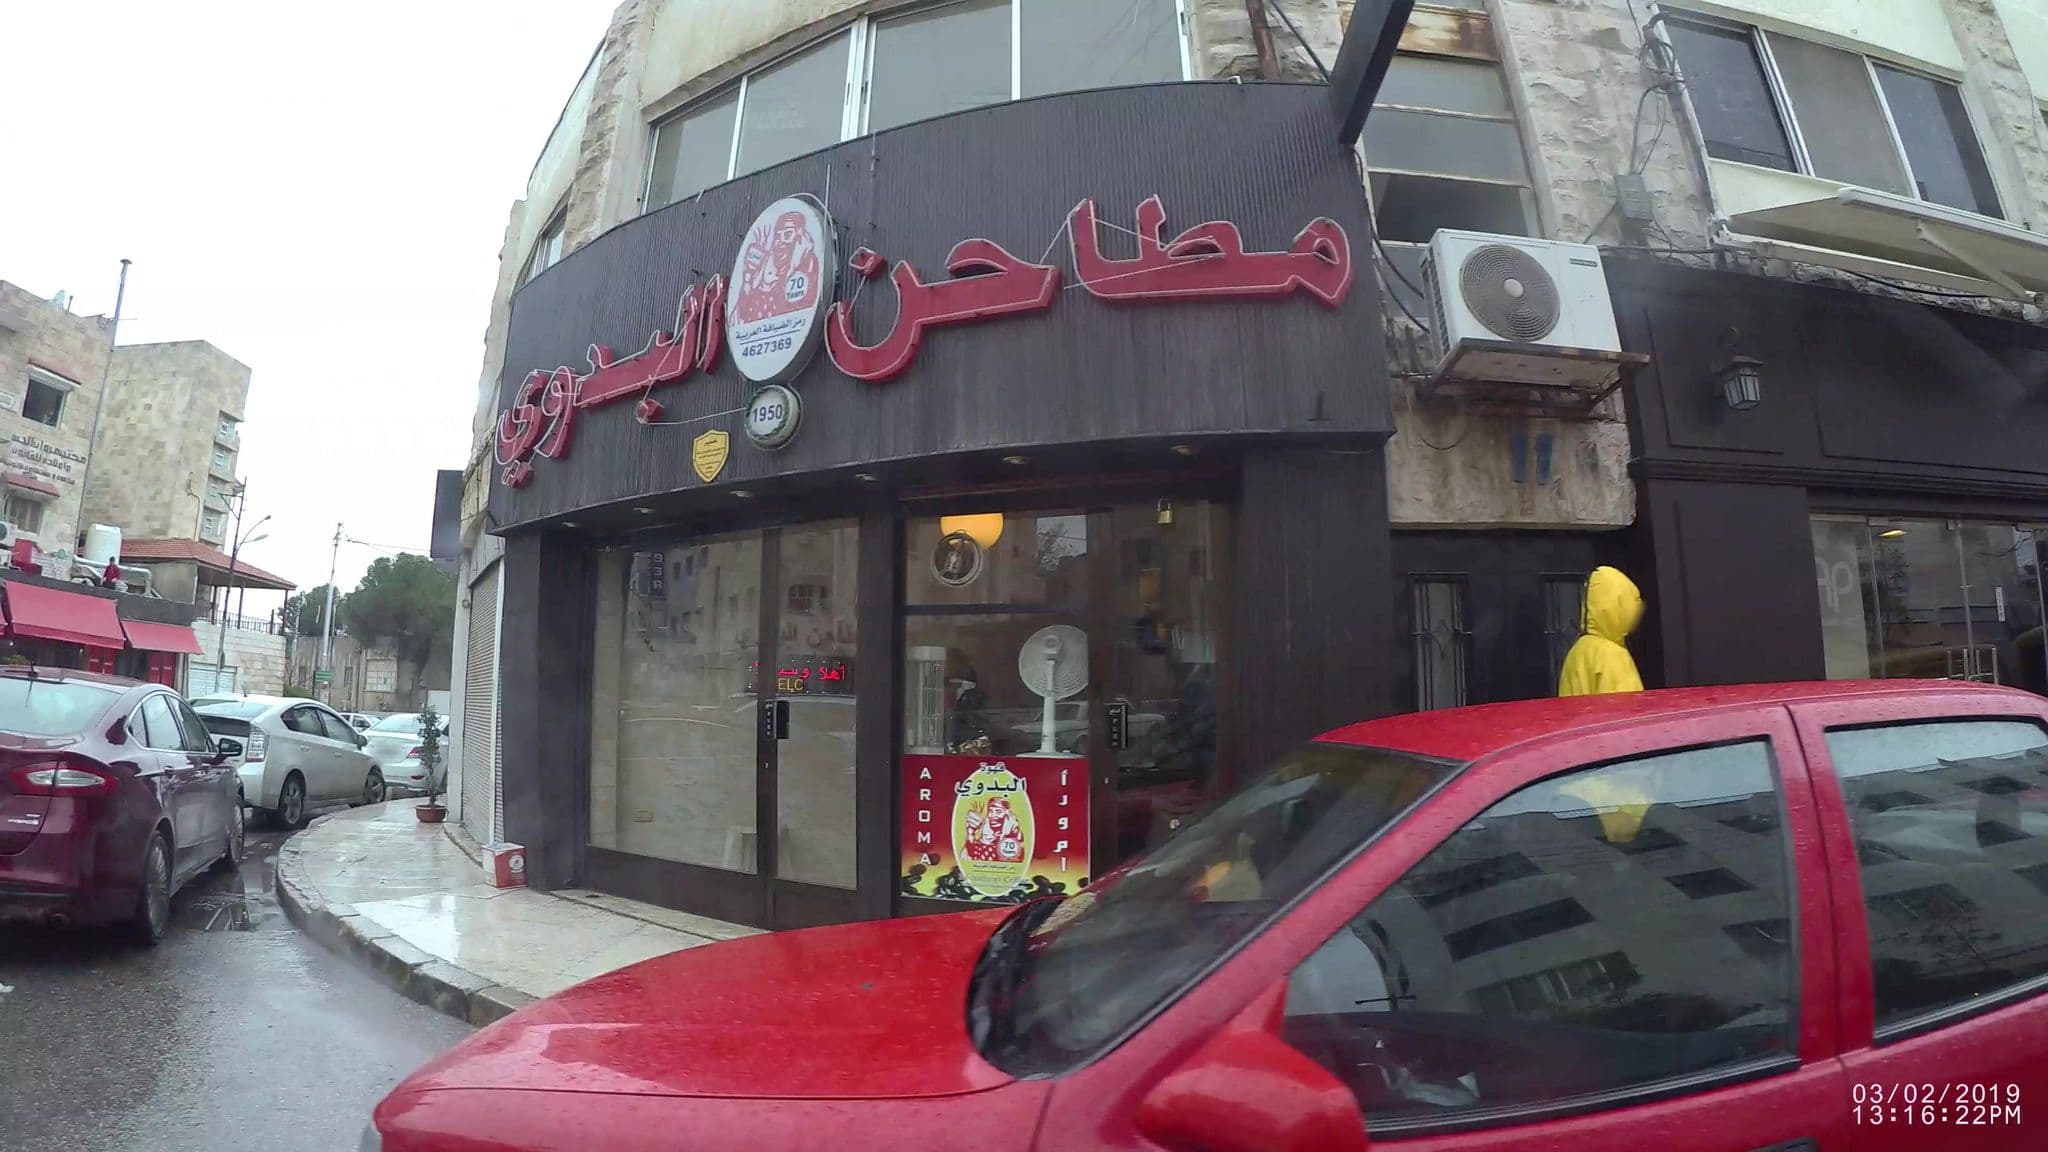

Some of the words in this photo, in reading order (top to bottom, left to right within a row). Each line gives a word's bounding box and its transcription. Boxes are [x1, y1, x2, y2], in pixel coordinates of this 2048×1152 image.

[790, 277, 804, 290] 70
[824, 194, 1355, 383] مطاحن
[763, 320, 792, 333] الضيافة
[792, 317, 806, 328] رمز
[736, 328, 762, 341] العربية
[742, 337, 792, 358] 4627369
[495, 273, 729, 489] البدوي
[753, 404, 783, 423] 1950
[980, 763, 1006, 775] قهوة
[956, 778, 1025, 798] البدوي
[917, 766, 932, 865] AROMA
[1004, 841, 1016, 850] 70
